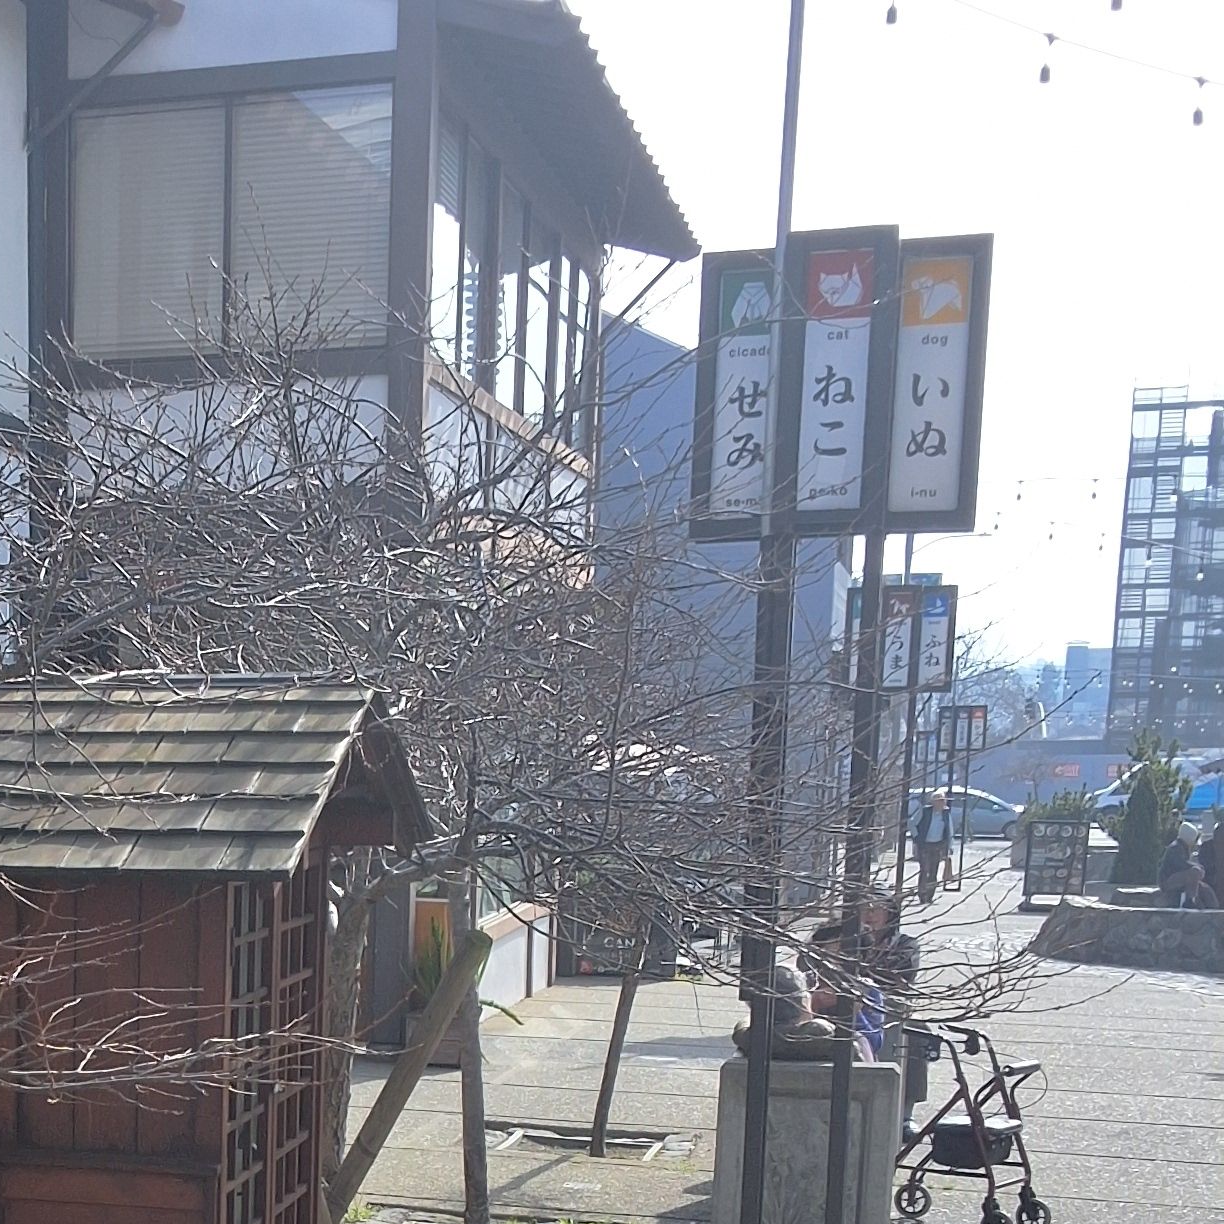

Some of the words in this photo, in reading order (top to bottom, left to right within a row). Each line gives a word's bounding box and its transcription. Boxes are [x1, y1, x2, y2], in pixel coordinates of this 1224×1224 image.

[827, 330, 849, 341] cat
[921, 333, 949, 347] dog
[727, 380, 768, 470] せみ
[812, 364, 855, 457] ねこ
[906, 373, 950, 457] いぬ
